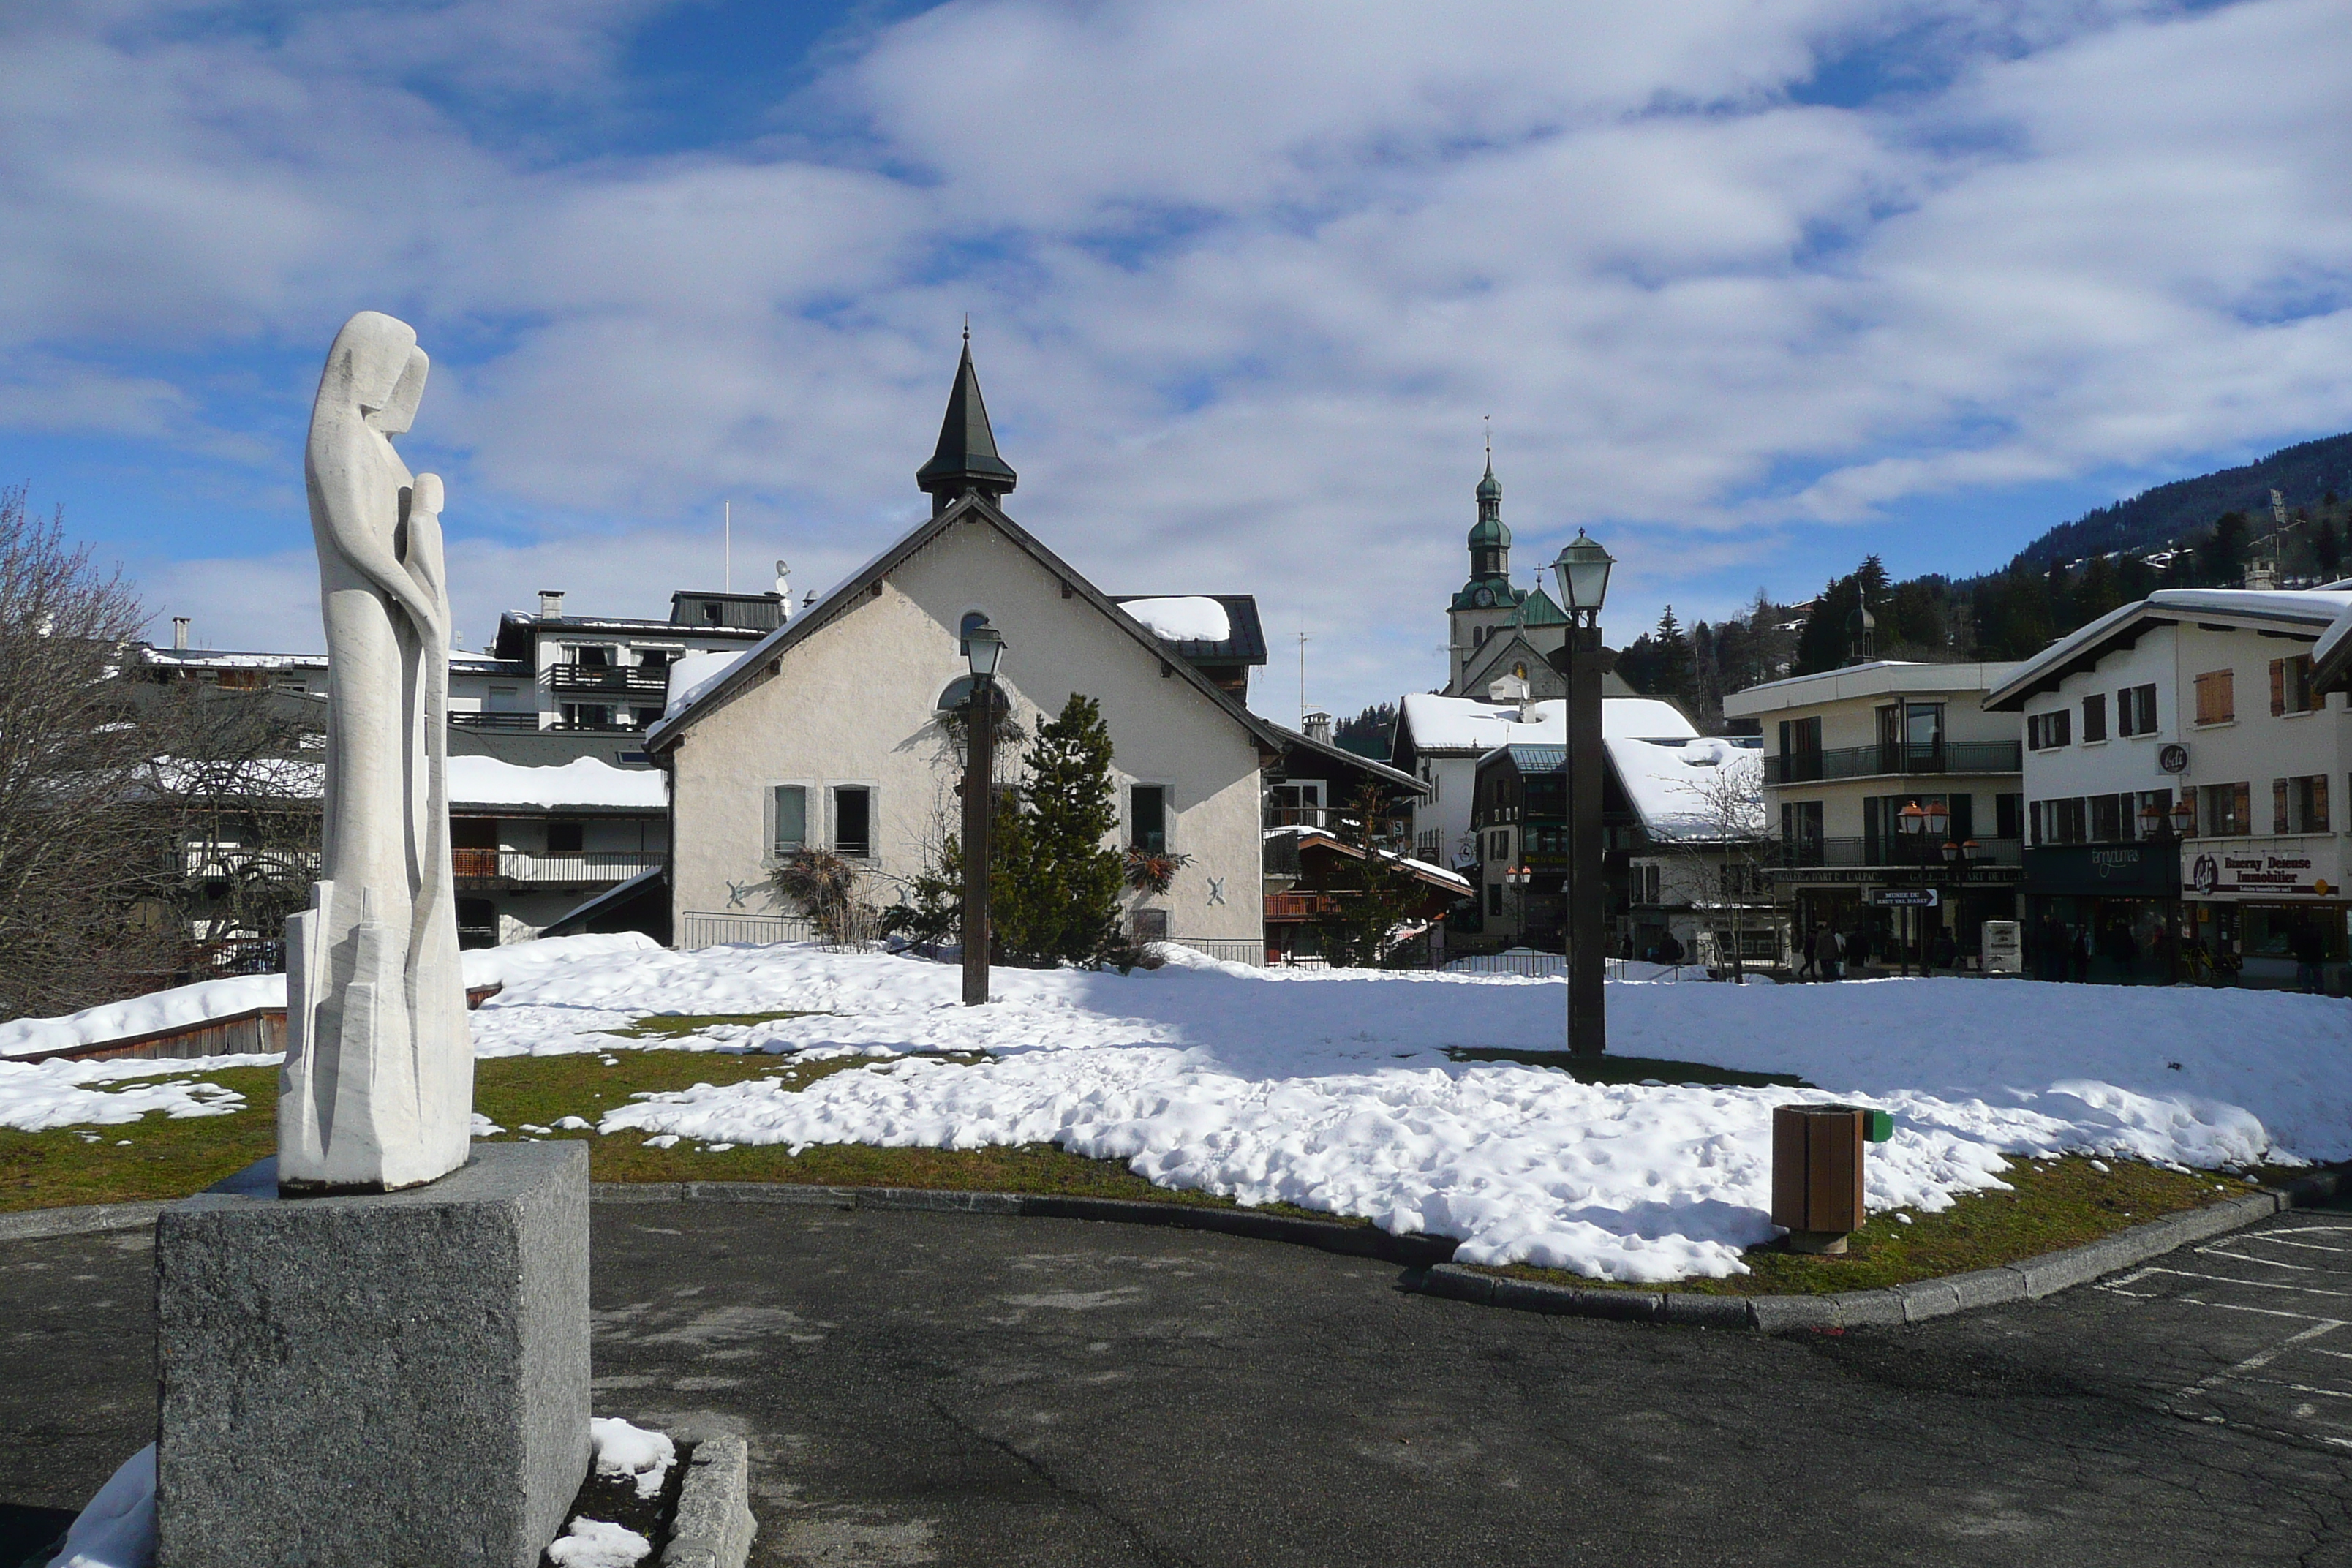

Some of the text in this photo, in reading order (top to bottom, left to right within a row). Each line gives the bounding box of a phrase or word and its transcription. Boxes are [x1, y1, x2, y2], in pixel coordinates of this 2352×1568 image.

[2165, 749, 2185, 769] bdi
[2195, 861, 2212, 890] bdi
[2236, 870, 2298, 883] Immobilier
